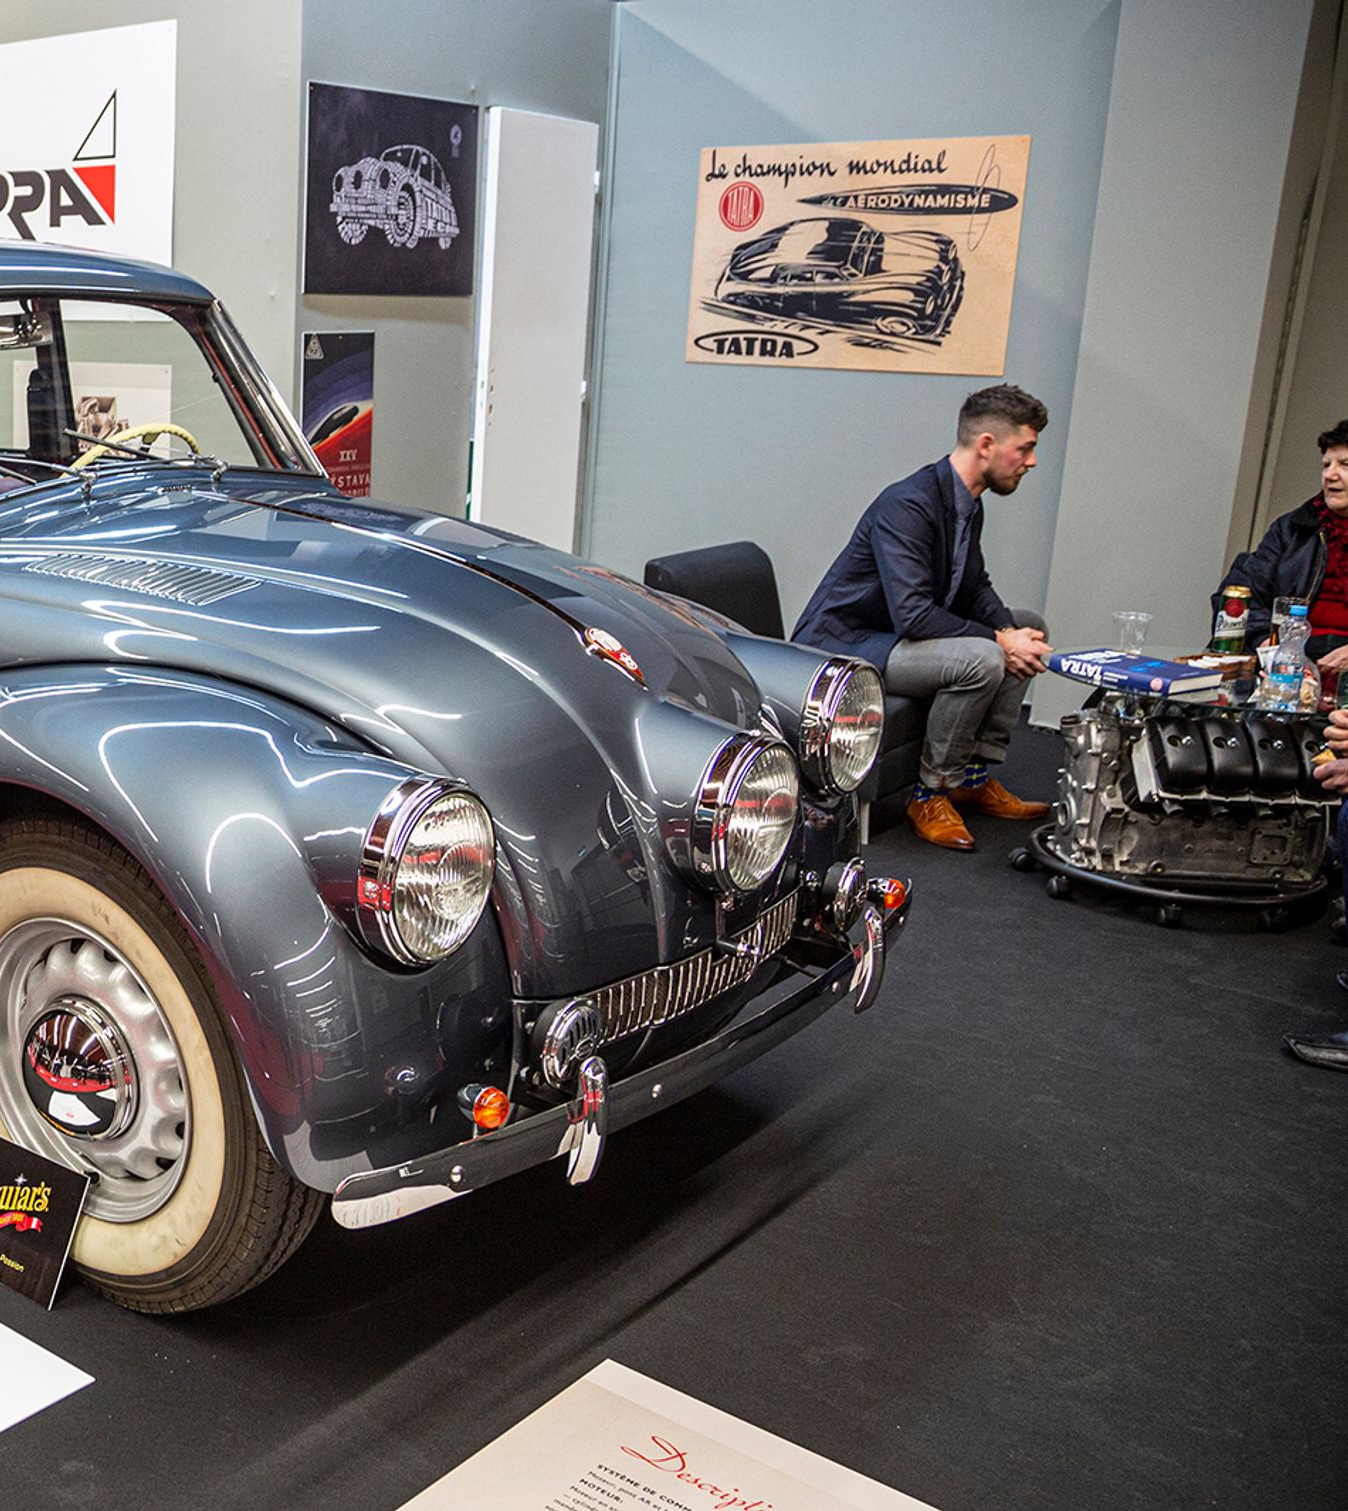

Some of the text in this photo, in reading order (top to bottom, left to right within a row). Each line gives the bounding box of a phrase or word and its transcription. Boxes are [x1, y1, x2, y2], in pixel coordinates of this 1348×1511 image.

[733, 152, 838, 189] champion
[846, 149, 951, 176] mondial
[727, 187, 755, 227] TATRA
[712, 335, 796, 360] TATRA
[1060, 658, 1103, 682] TATRA
[620, 1435, 773, 1511] Descript
[642, 1486, 657, 1496] DE
